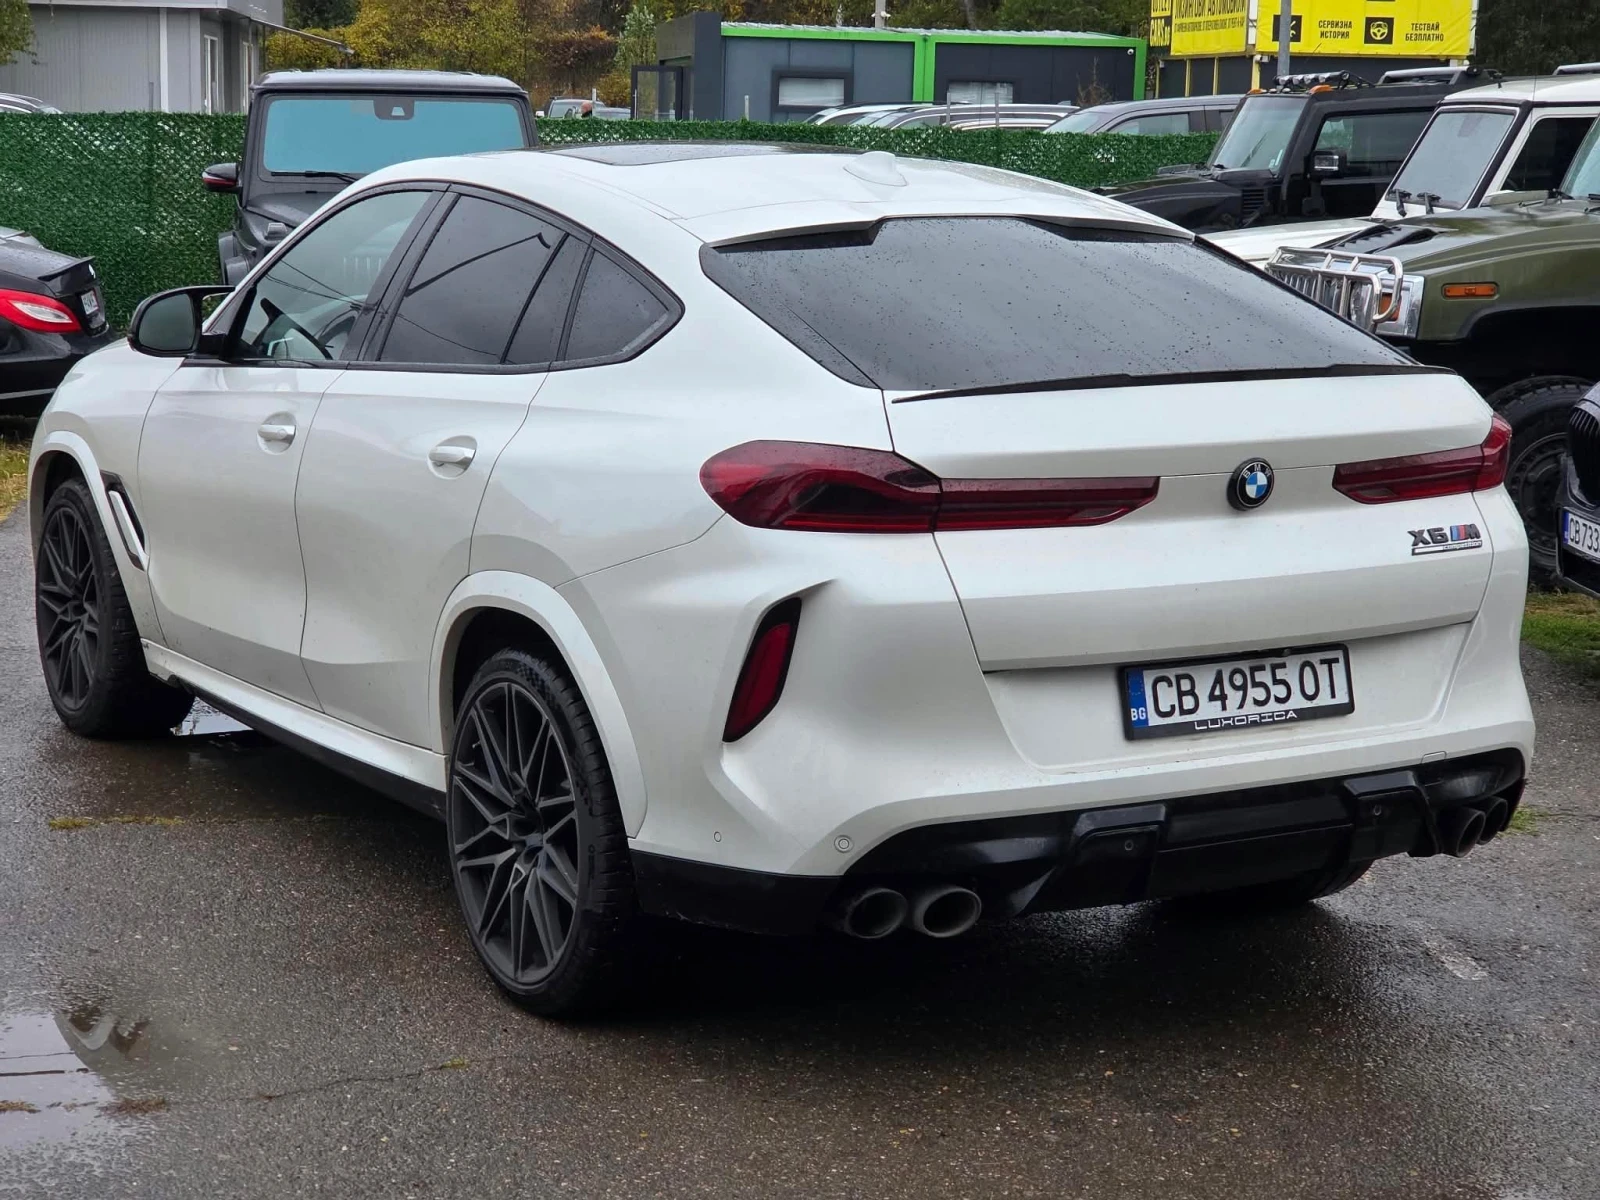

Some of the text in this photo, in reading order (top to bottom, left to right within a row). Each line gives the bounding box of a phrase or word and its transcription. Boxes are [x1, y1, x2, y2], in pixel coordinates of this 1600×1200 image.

[1318, 20, 1352, 29] СЕРВИЗНА
[1411, 22, 1440, 31] ТЕСТВАЙ
[1320, 30, 1350, 39] ИСТОРИЯ
[1405, 33, 1444, 42] БЕЗПЛАТНО
[1582, 522, 1600, 553] 733
[1152, 673, 1200, 718] CB
[1208, 662, 1292, 711] 4955
[1131, 707, 1147, 721] BG
[1194, 710, 1298, 730] LUXORICA
